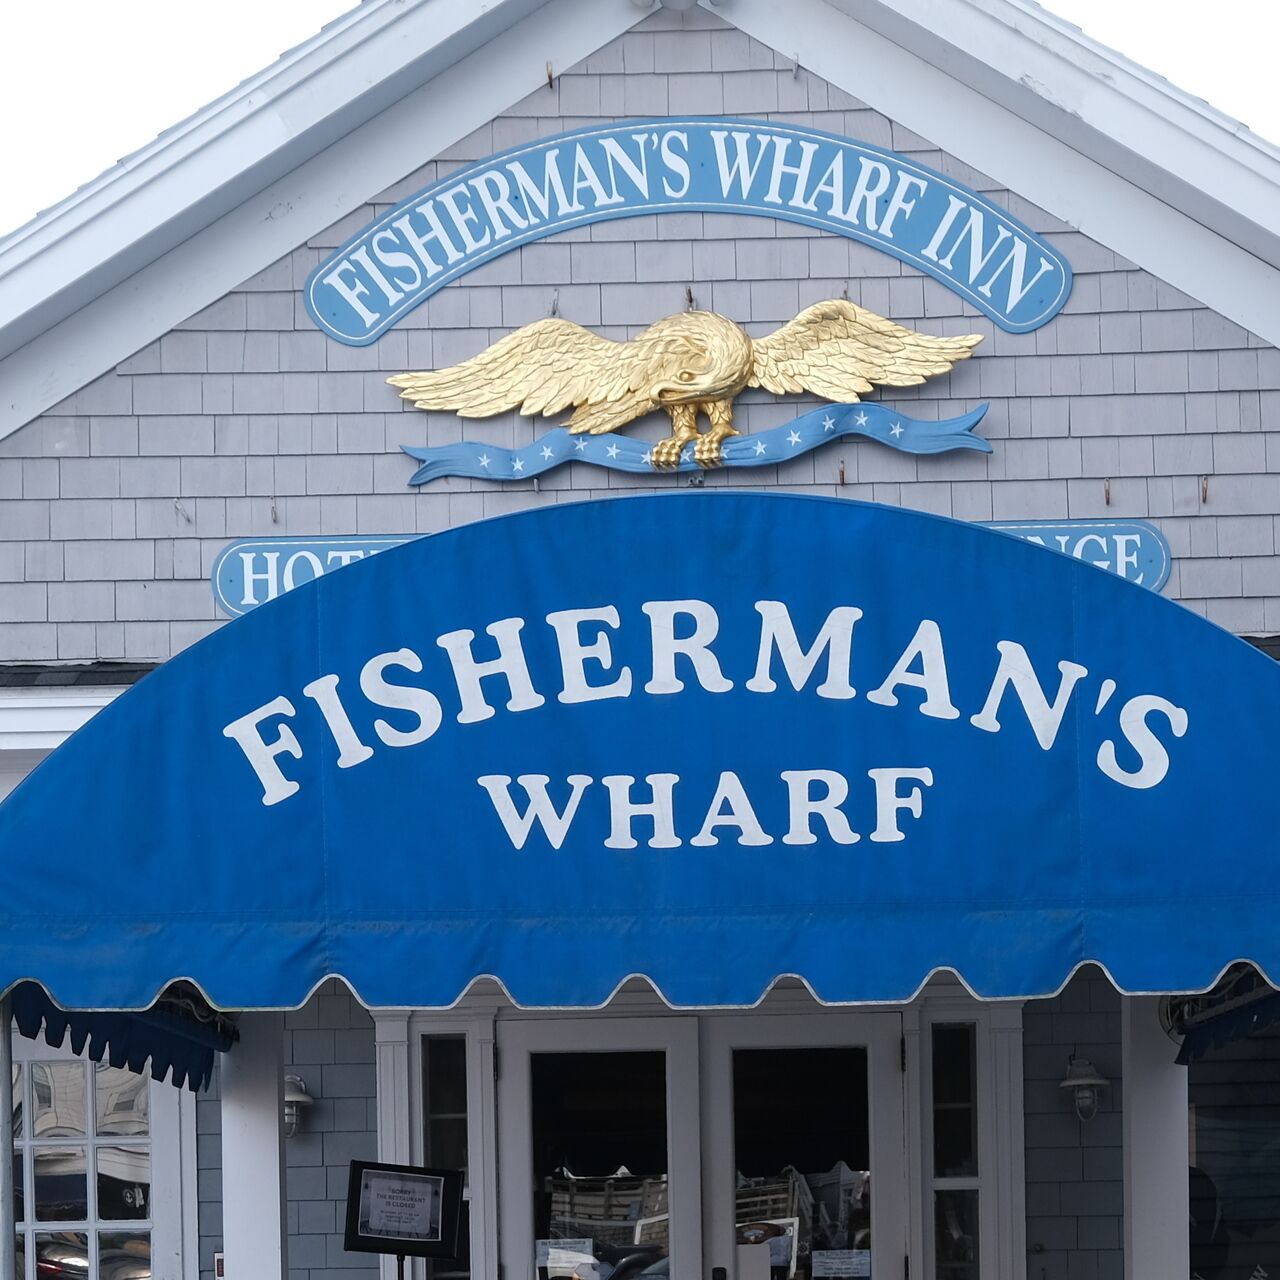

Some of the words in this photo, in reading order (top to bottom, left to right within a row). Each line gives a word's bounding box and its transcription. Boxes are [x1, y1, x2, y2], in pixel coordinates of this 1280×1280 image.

[322, 129, 691, 329] FISHERMAN'S
[709, 129, 929, 239] WHARF
[920, 194, 1055, 315] INN
[222, 599, 1189, 806] FISHERMAN'S
[477, 766, 934, 850] WHARF
[392, 1201, 416, 1209] CLOSED
